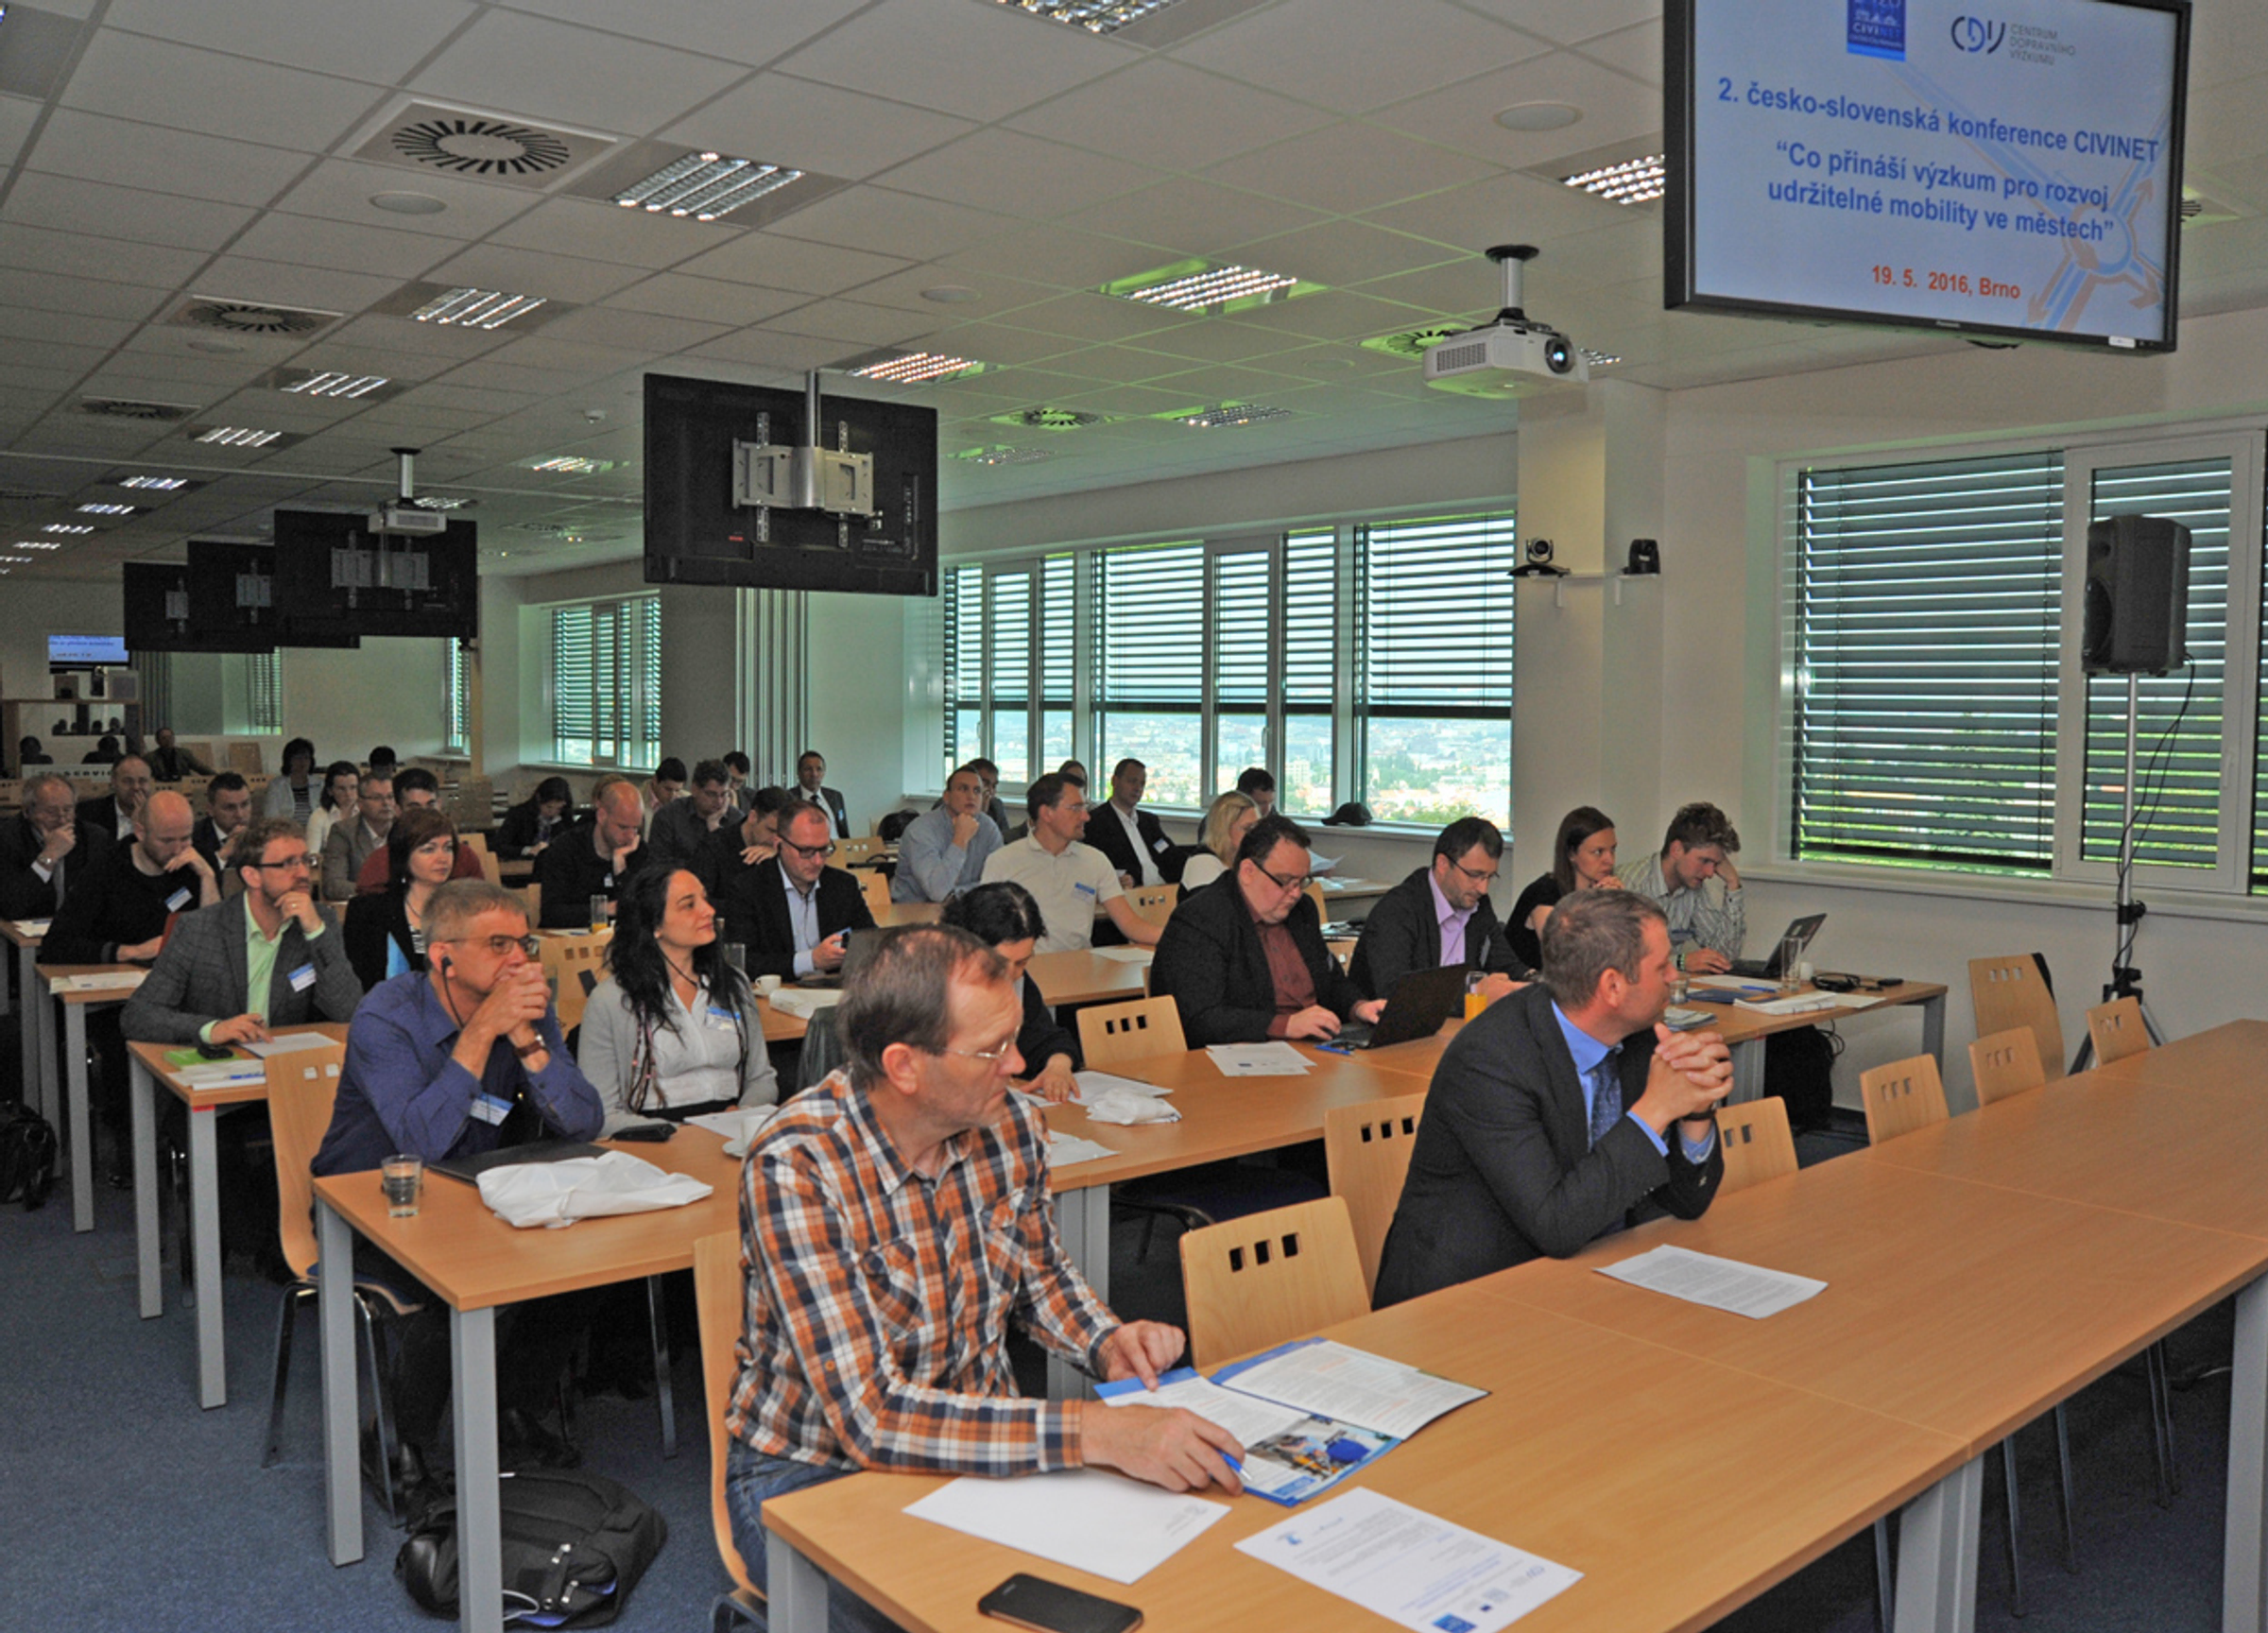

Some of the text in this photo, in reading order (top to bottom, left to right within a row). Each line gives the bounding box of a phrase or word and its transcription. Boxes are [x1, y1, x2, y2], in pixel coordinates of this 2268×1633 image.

[2010, 23, 2058, 40] CENTRUM
[1718, 77, 2159, 163] 2. česko-slovenská konference CIVINET
[1769, 180, 1882, 214] udržitelné
[1890, 197, 1978, 231] mobility
[1984, 210, 2008, 230] ve
[1829, 149, 1906, 180] přináší
[1914, 161, 1996, 191] výzkum
[2003, 177, 2039, 199] pro
[2045, 185, 2108, 212] rozvoj
[1872, 265, 2021, 299] 19. 5. 2016, Brno
